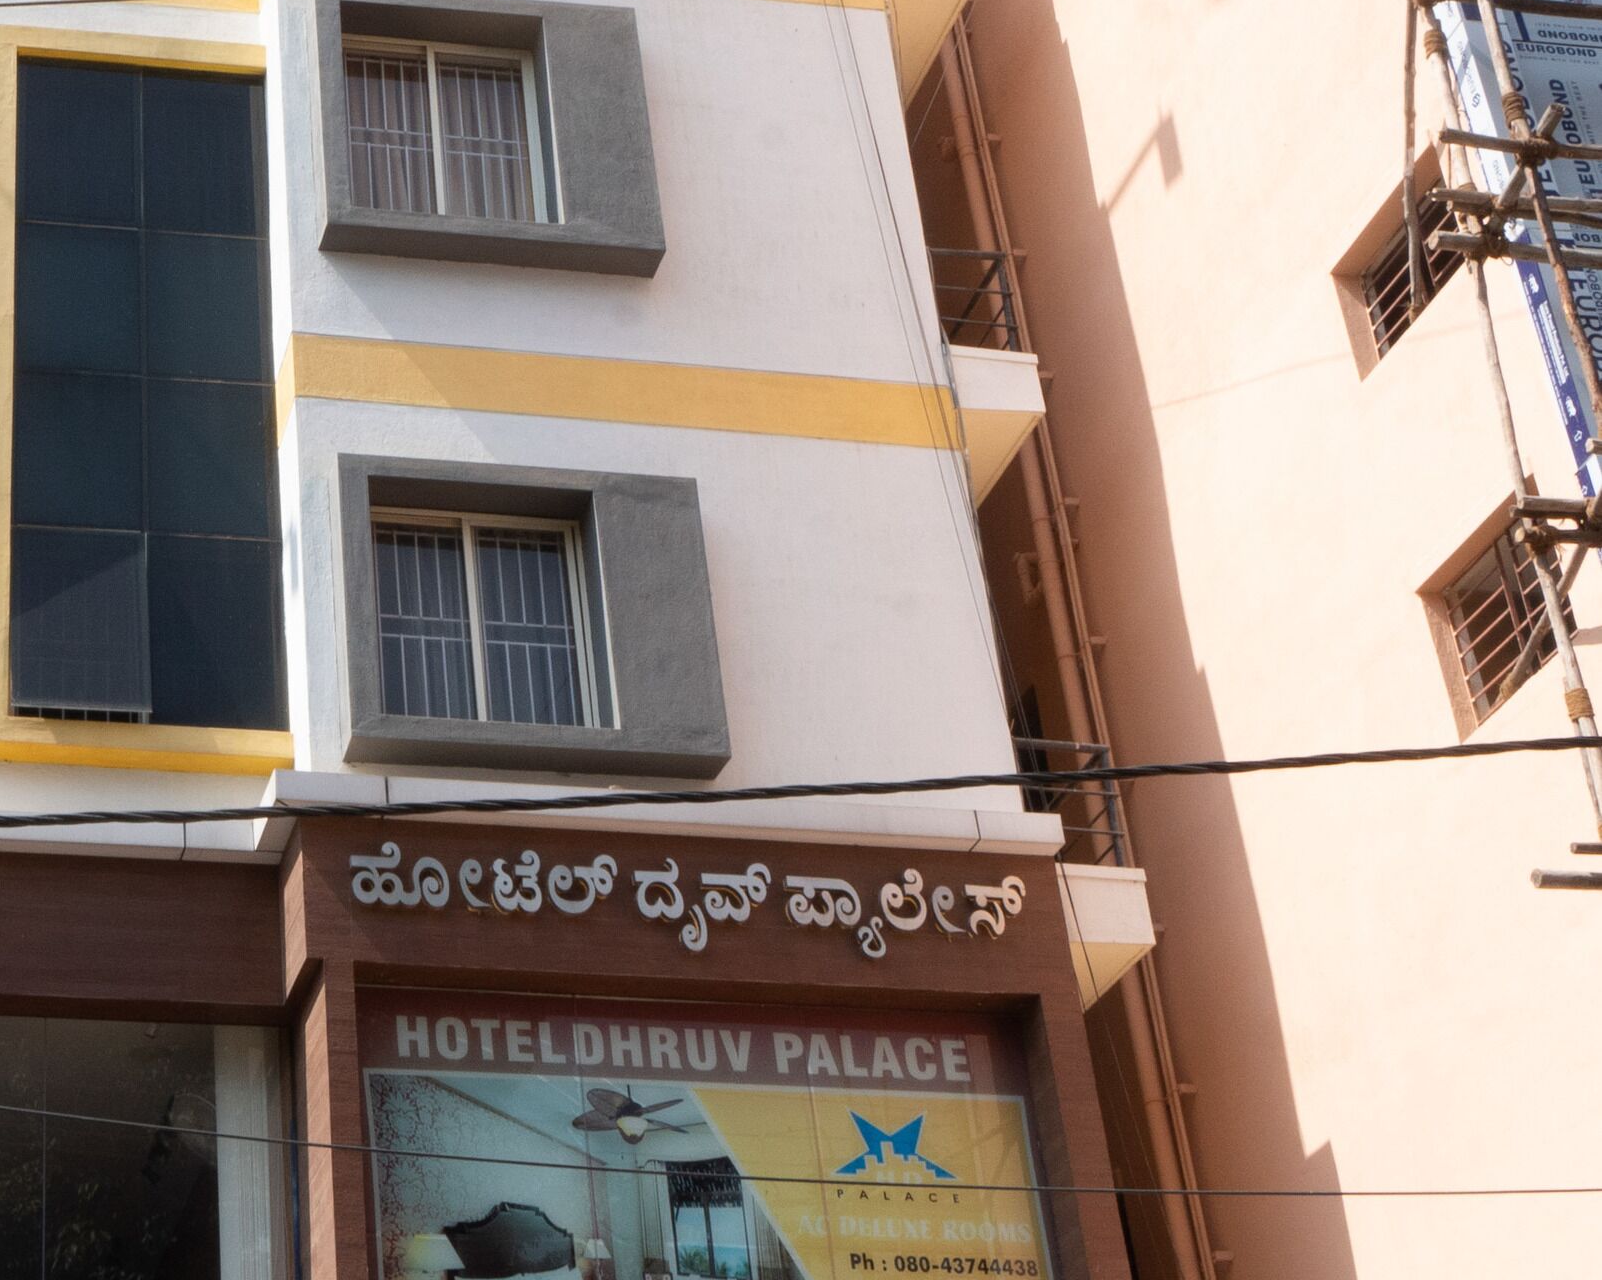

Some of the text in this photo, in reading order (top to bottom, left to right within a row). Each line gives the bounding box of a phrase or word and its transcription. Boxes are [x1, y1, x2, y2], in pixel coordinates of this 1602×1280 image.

[1517, 42, 1597, 59] EUROBOND
[349, 841, 618, 916] ಹೋಟೆಲ್
[396, 1013, 972, 1084] HOTEL DHRUV PALACE
[836, 1189, 960, 1204] PALACE
[850, 1253, 875, 1271] Ph
[894, 1255, 1039, 1277] 080-43744438
